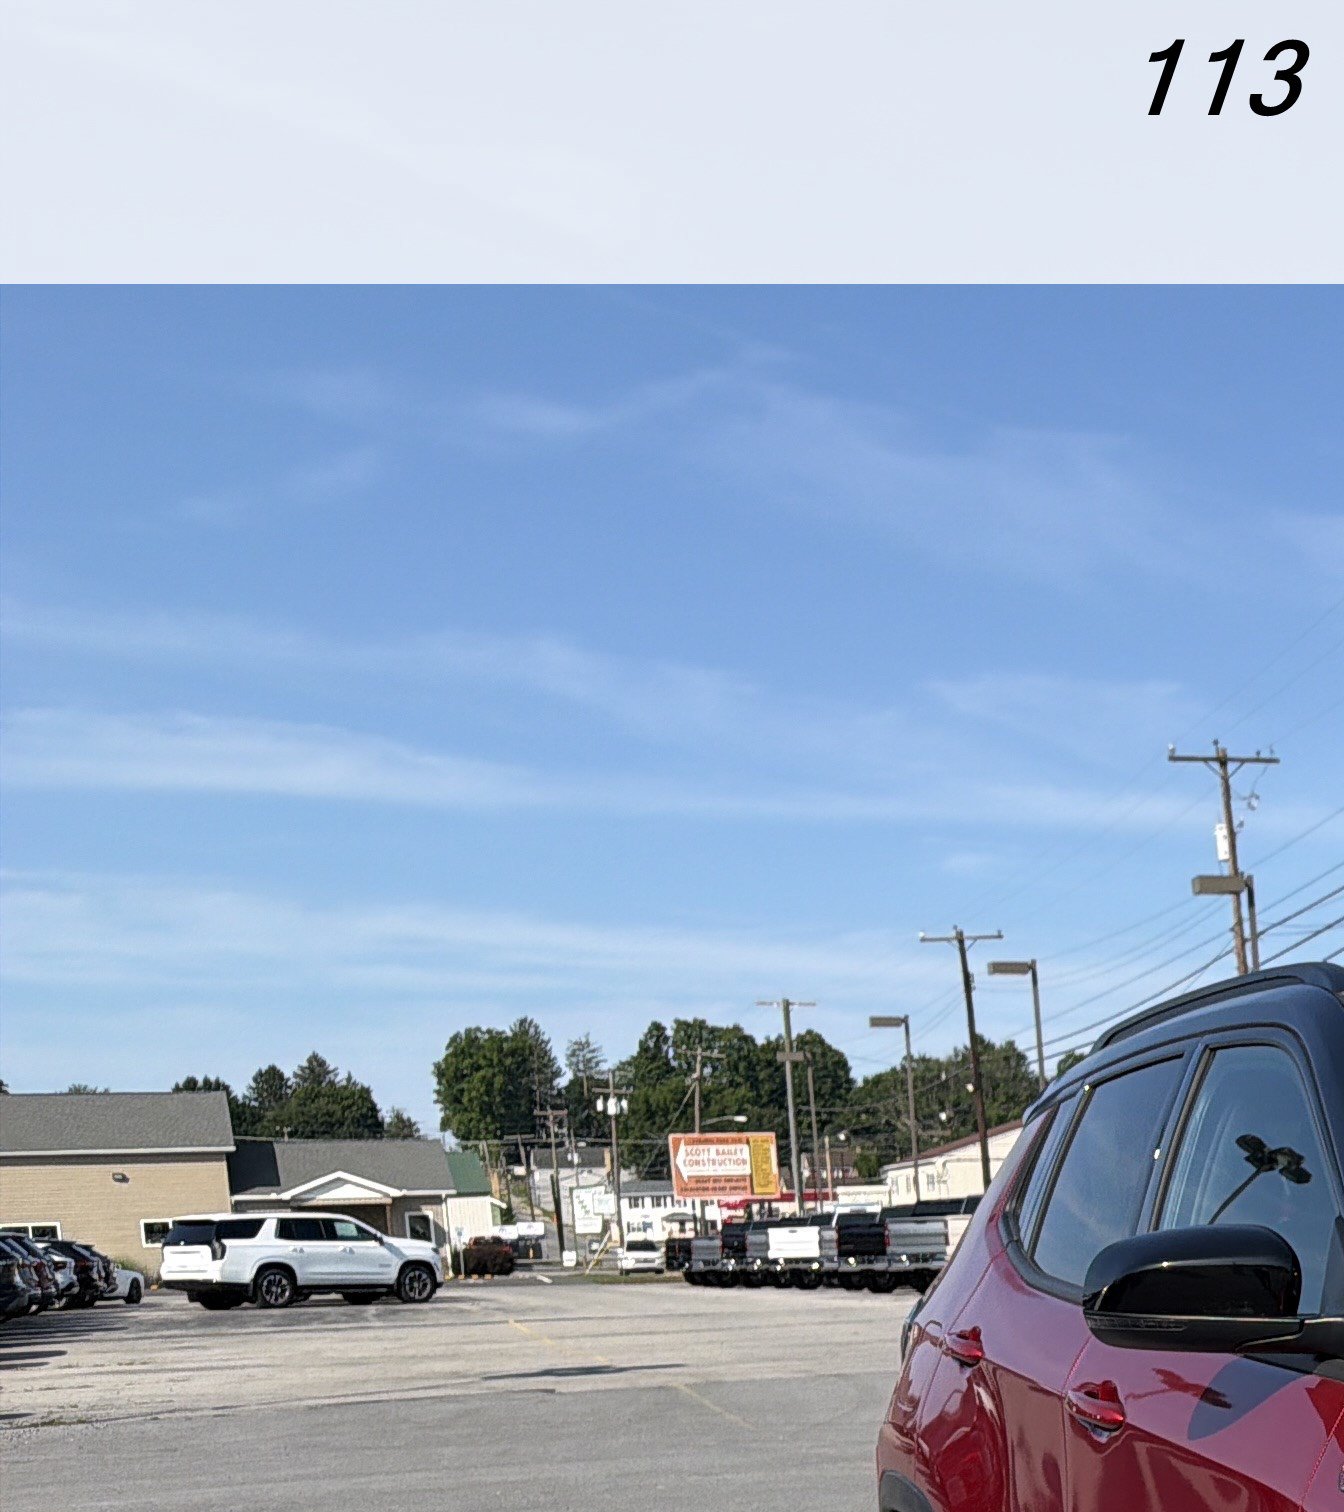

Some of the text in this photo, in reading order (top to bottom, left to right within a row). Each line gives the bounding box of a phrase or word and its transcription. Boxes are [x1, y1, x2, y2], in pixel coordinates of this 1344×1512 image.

[684, 1146, 744, 1157] SCOTT BAILEY
[683, 1157, 748, 1168] CONSTRUCTION
